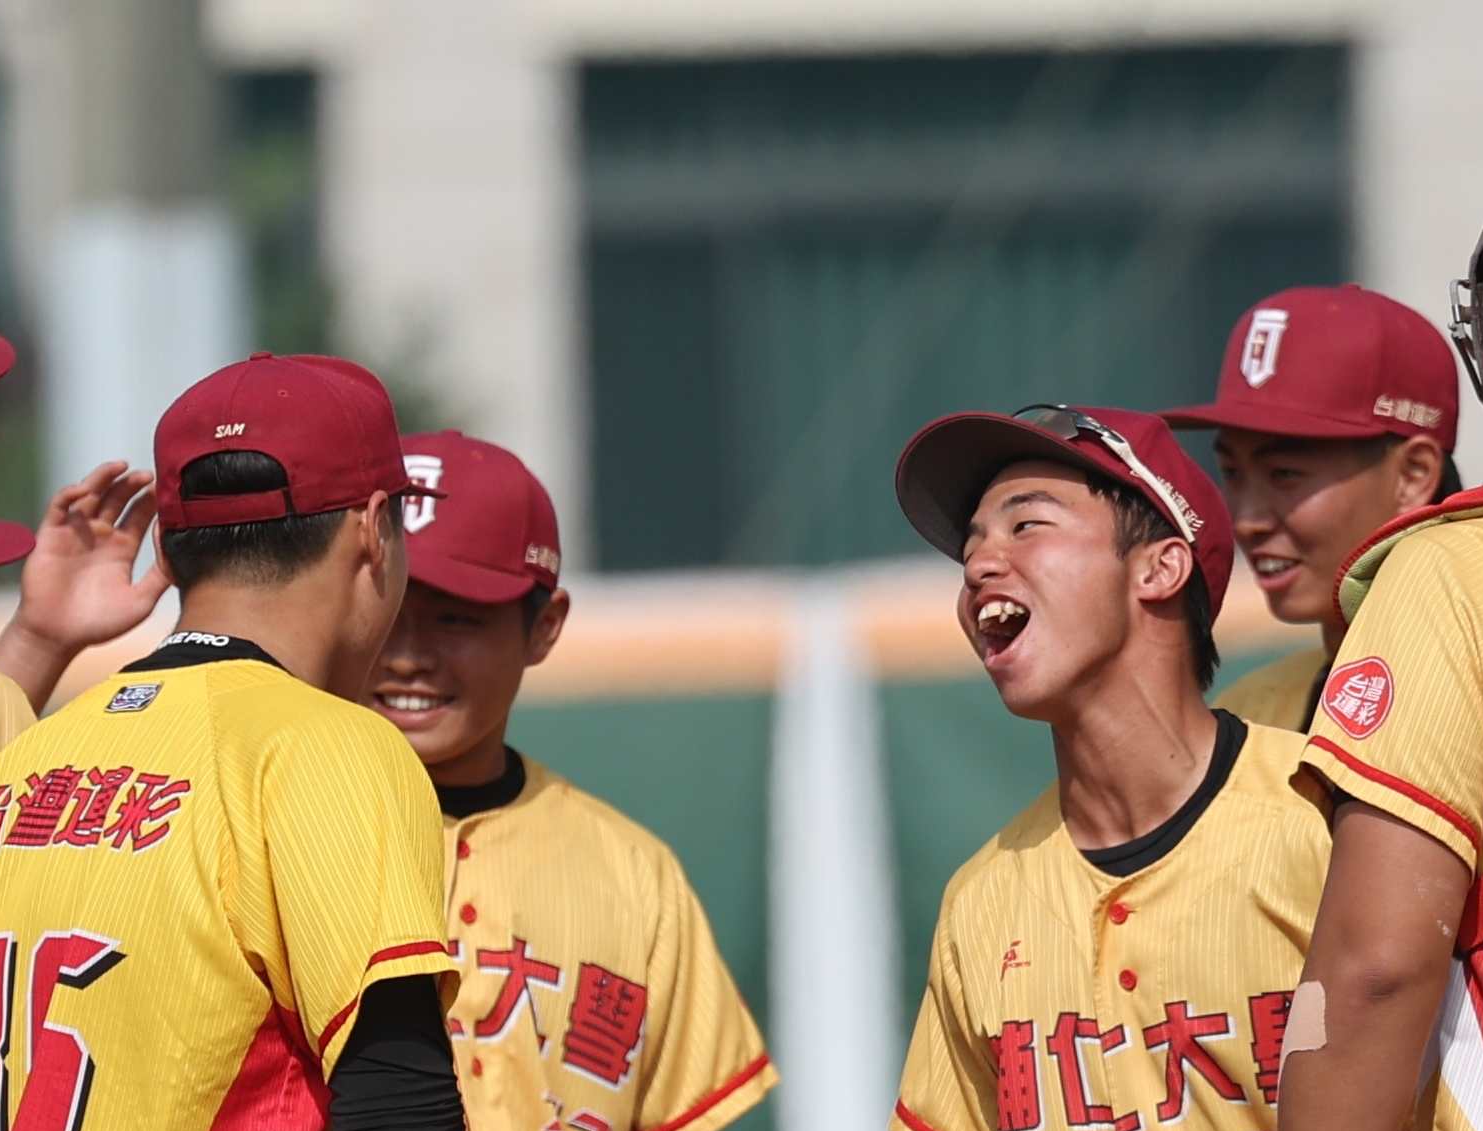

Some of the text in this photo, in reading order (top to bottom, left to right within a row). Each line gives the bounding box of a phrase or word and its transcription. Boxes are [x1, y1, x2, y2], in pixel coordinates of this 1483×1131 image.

[214, 422, 246, 439] SAM
[185, 632, 230, 647] PRO
[447, 934, 648, 1092] 大學
